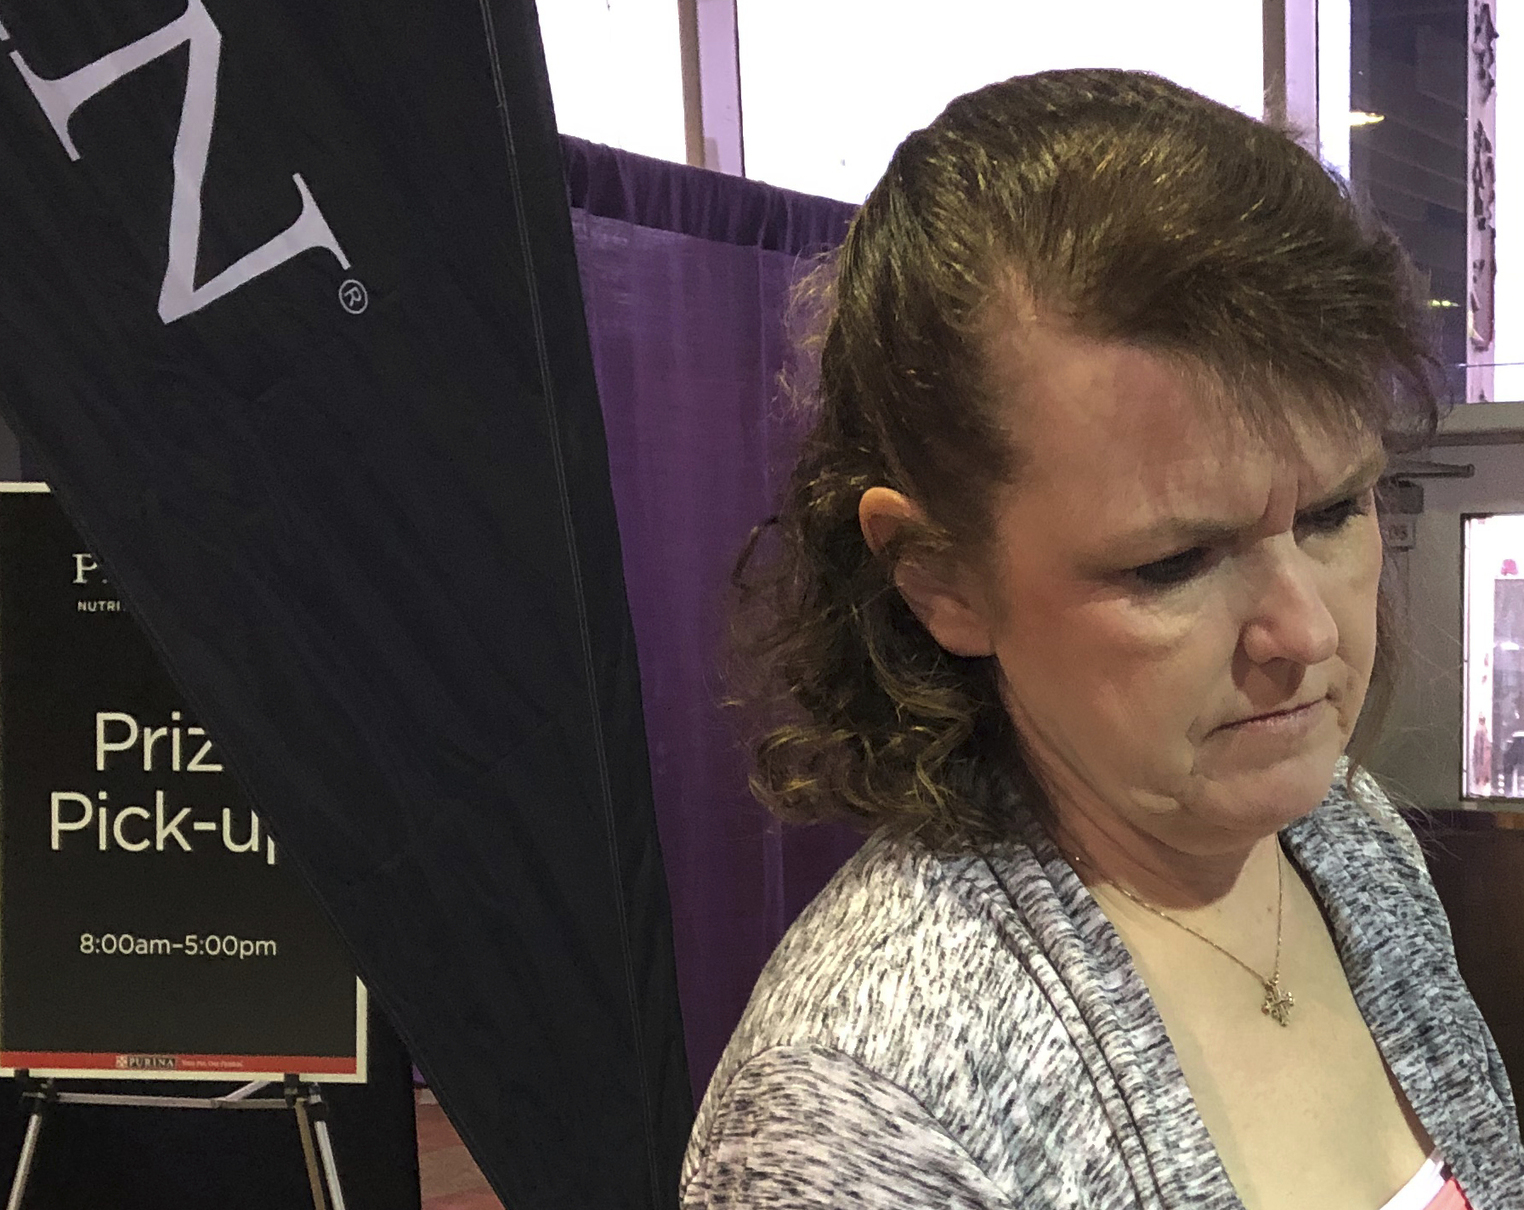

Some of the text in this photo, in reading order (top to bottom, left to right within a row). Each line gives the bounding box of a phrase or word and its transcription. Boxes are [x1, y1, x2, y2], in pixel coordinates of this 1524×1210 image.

[77, 600, 125, 612] NUTRI
[96, 711, 224, 771] Priz
[79, 933, 277, 960] 8:00am-5:00pm
[127, 1057, 175, 1069] PURINA
